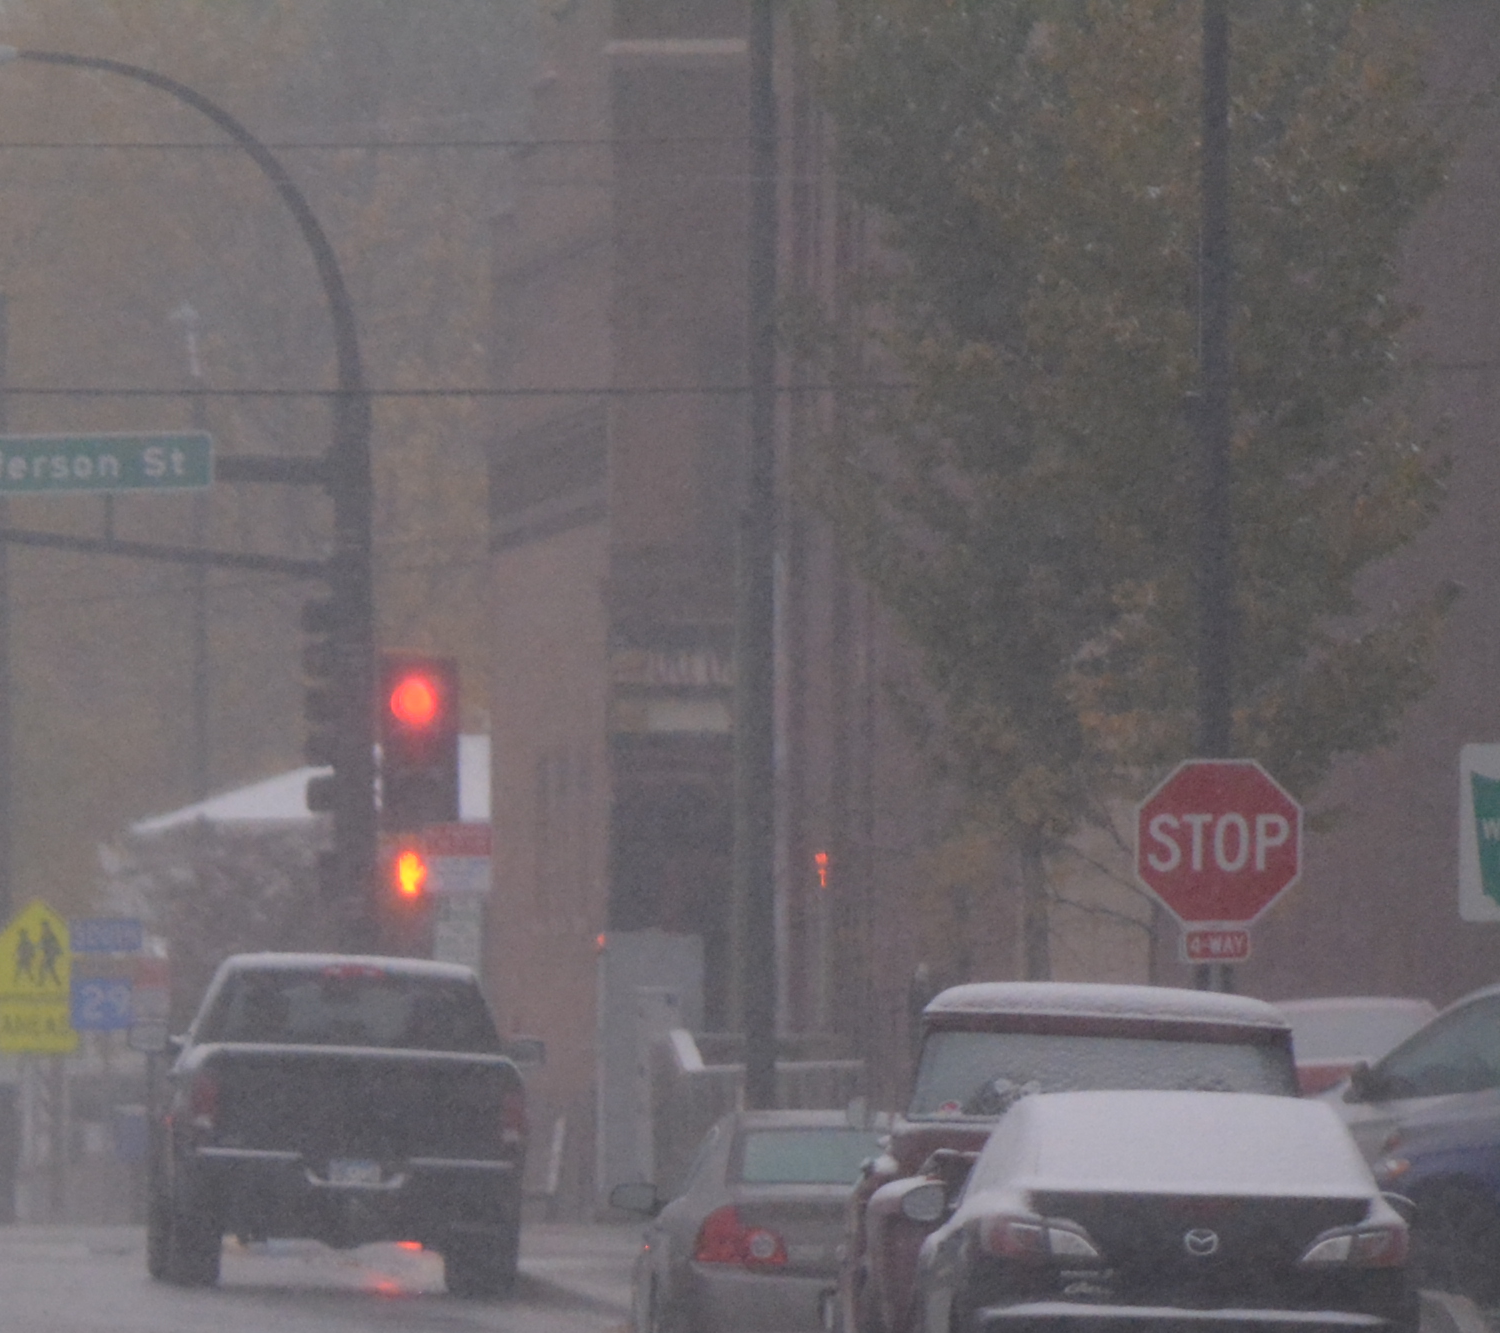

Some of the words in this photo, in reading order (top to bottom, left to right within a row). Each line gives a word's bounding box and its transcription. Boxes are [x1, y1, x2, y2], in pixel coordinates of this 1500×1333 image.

[142, 447, 187, 477] St
[1148, 813, 1290, 873] STOP
[1189, 935, 1245, 954] 4-WAY
[80, 983, 132, 1022] 29
